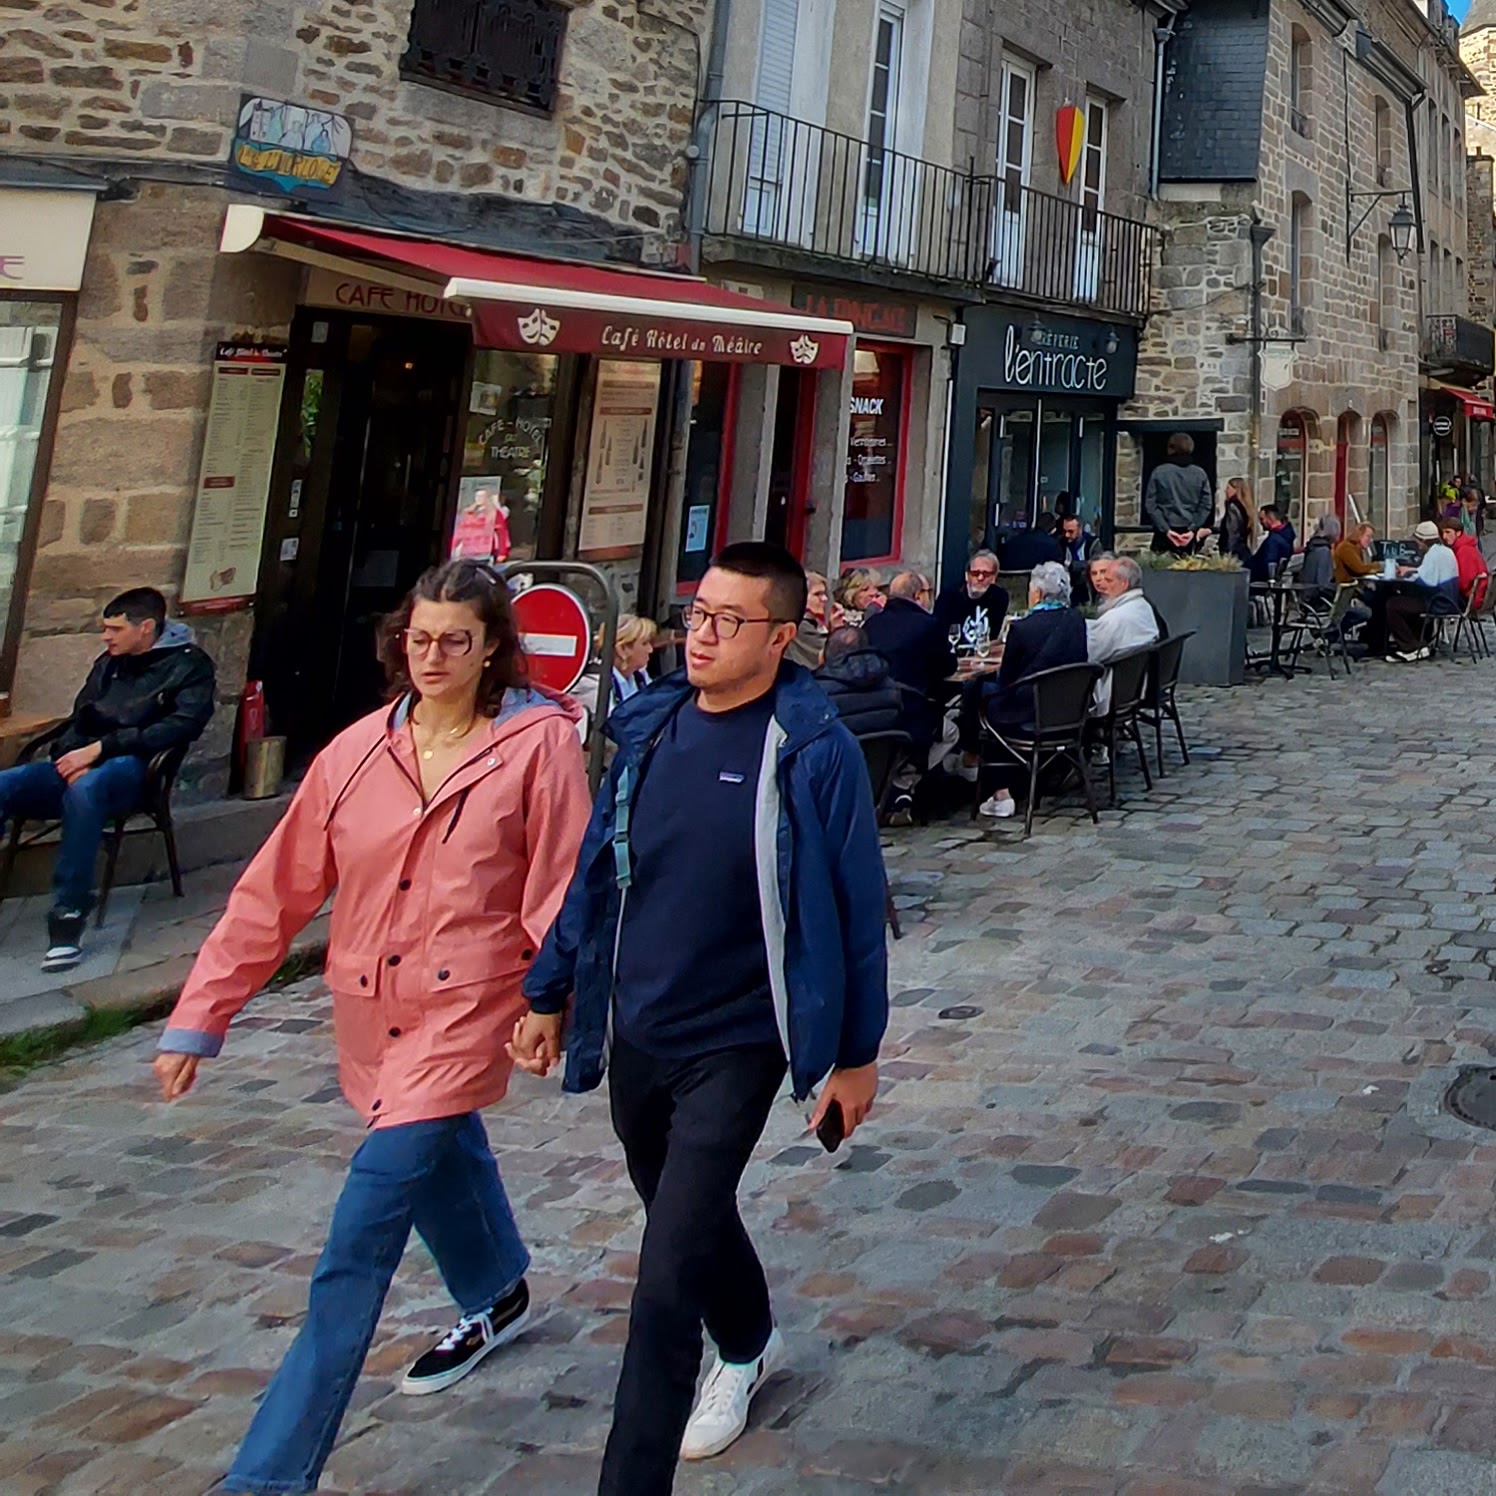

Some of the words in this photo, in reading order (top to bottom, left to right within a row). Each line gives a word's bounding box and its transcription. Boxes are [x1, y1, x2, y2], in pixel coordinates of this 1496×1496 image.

[601, 325, 640, 351] Café
[646, 329, 688, 351] Hôtel
[1004, 324, 1107, 390] l'entracte
[850, 397, 884, 415] SNACK
